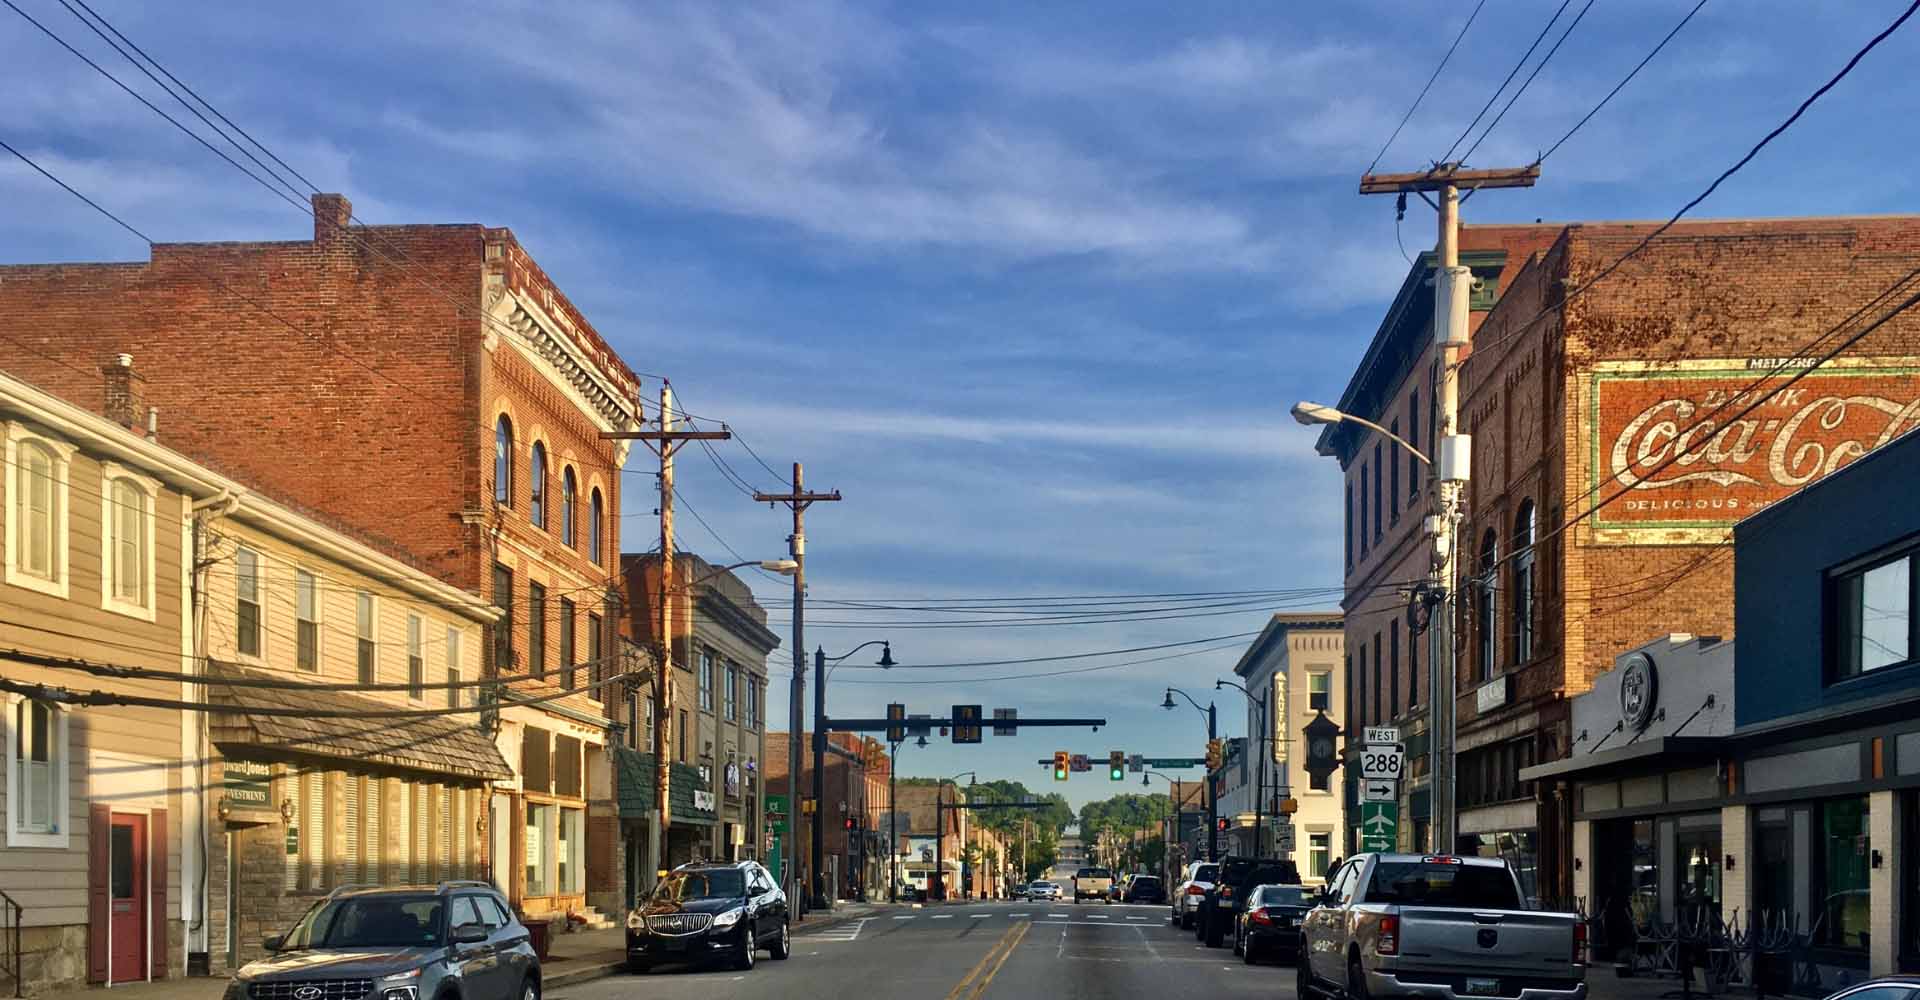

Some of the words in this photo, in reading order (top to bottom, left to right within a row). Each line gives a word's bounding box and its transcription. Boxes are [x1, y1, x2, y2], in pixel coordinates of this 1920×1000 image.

[1700, 388, 1808, 408] DRINK
[1625, 498, 1739, 511] DELICIOUS
[1368, 729, 1395, 741] WEST
[223, 759, 247, 773] dward
[246, 760, 270, 776] Jones
[1364, 753, 1399, 773] 288
[224, 788, 266, 801] VESTMENTS
